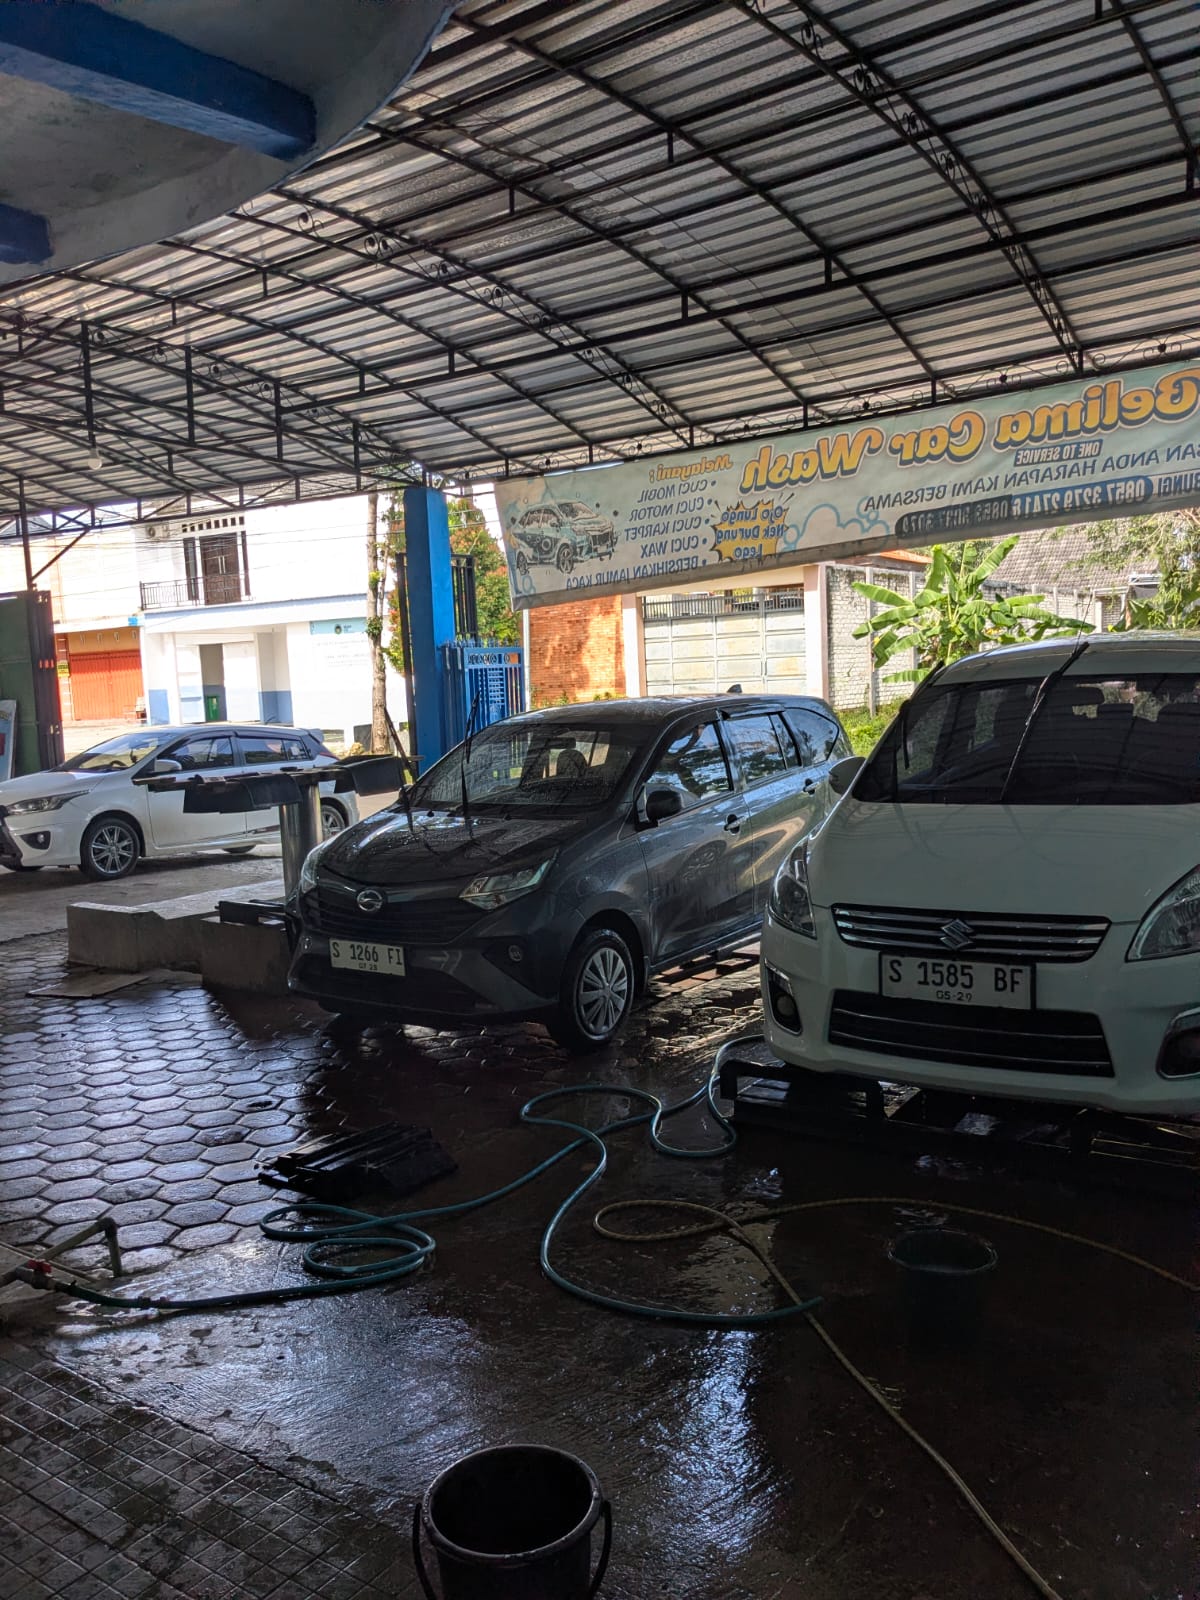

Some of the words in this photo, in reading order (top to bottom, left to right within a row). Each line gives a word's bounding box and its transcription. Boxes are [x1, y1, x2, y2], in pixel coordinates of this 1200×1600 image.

[332, 941, 340, 958] S
[349, 943, 379, 962] 1266
[387, 947, 402, 966] FI
[889, 959, 902, 983] S
[917, 961, 973, 989] 1585
[994, 967, 1023, 993] BF
